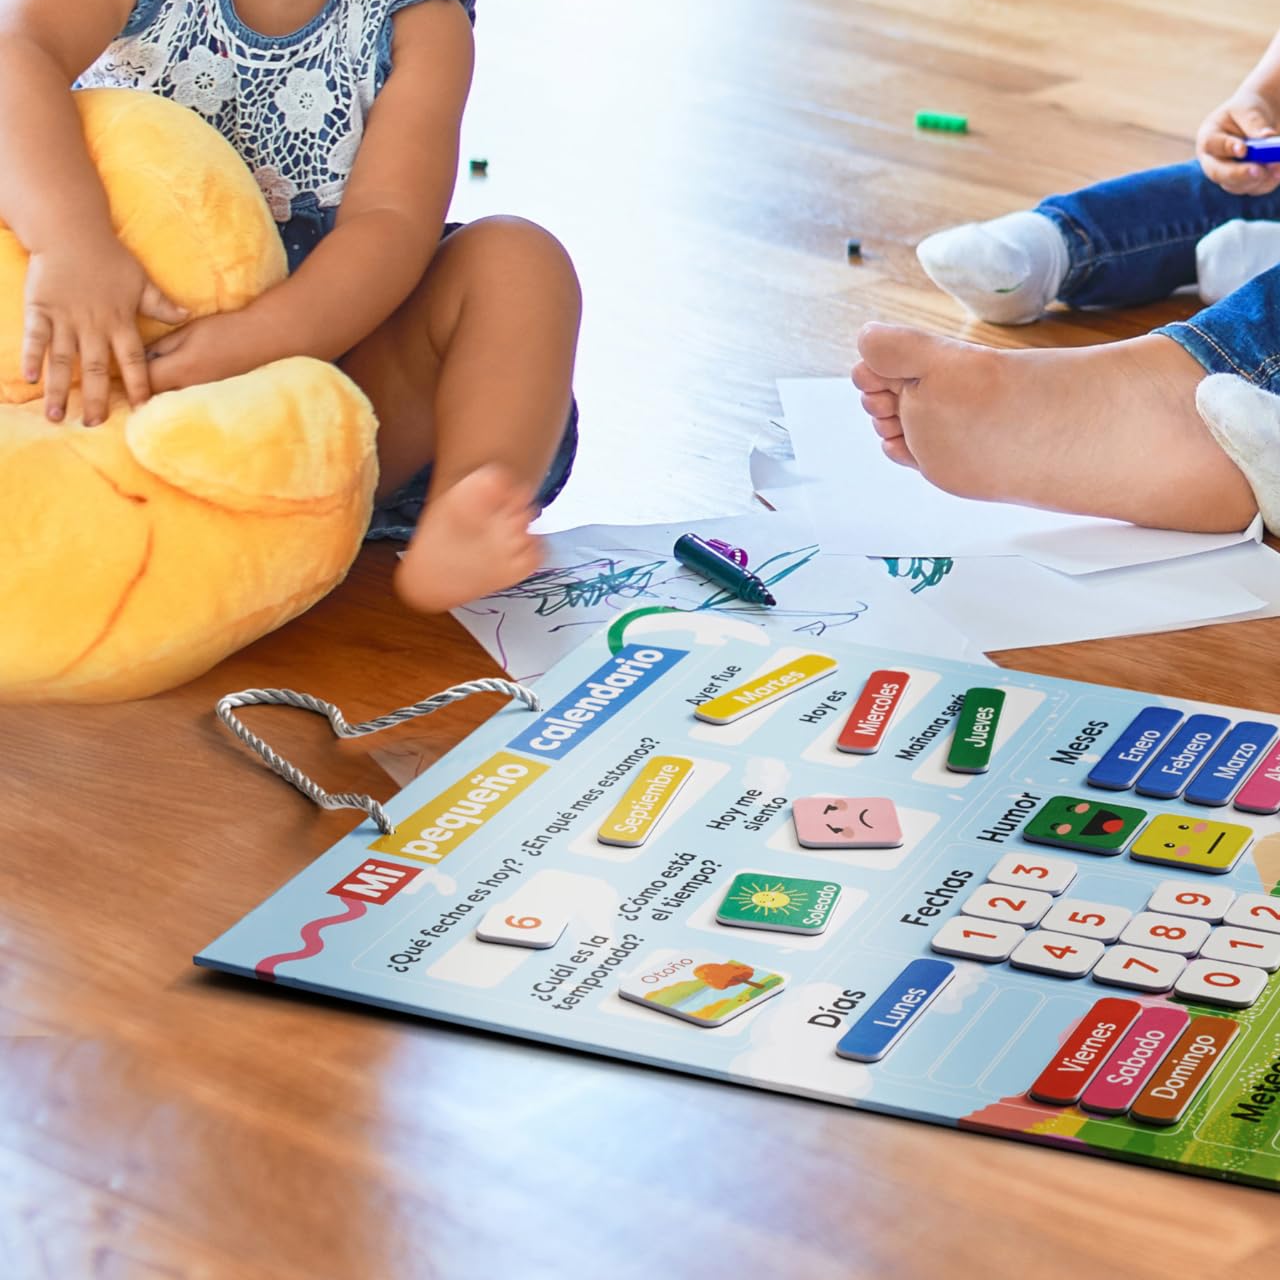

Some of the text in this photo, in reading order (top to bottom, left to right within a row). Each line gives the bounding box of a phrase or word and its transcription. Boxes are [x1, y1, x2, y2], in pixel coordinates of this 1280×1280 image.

[685, 664, 742, 707] Ayer fue
[733, 669, 806, 704] Martes
[799, 688, 848, 724] Hoy es
[854, 681, 900, 736] Miercoles
[965, 706, 995, 748] Jueves
[895, 717, 948, 761] Mañana
[1050, 719, 1109, 766] Meses
[1118, 729, 1161, 763] Enero
[1161, 731, 1213, 776] Febrero
[342, 648, 664, 898] Mi pequeño calendario
[1213, 742, 1257, 781] Marzo
[521, 736, 661, 857] ¿En qué mes estamos?
[614, 763, 680, 834] Septiembre
[706, 788, 763, 831] Hoy me
[744, 796, 788, 832] siento
[976, 791, 1042, 844] Humor
[618, 852, 697, 921] ¿Cómo está
[652, 858, 722, 921] el tiempo?
[1011, 863, 1049, 879] 3
[387, 857, 523, 973] ¿Qué fecha es hoy?
[803, 884, 838, 926] Soleado
[900, 869, 974, 927] Fechas
[987, 895, 1026, 912] 2
[1068, 911, 1106, 927] 5
[505, 914, 543, 930] 6
[962, 929, 997, 940] 1
[1149, 925, 1187, 940] 8
[1043, 944, 1078, 960] 4
[1122, 957, 1159, 974] 7
[1229, 939, 1264, 949] 1
[530, 935, 609, 1002] ¿Cuál es la
[552, 932, 645, 1012] temporada?
[641, 956, 694, 985] Otoño
[807, 988, 866, 1029] Días
[873, 986, 927, 1029] Lunes
[1057, 1021, 1116, 1074] Viernes
[1106, 1029, 1166, 1086] Sabado
[1151, 1034, 1217, 1100] Domingo
